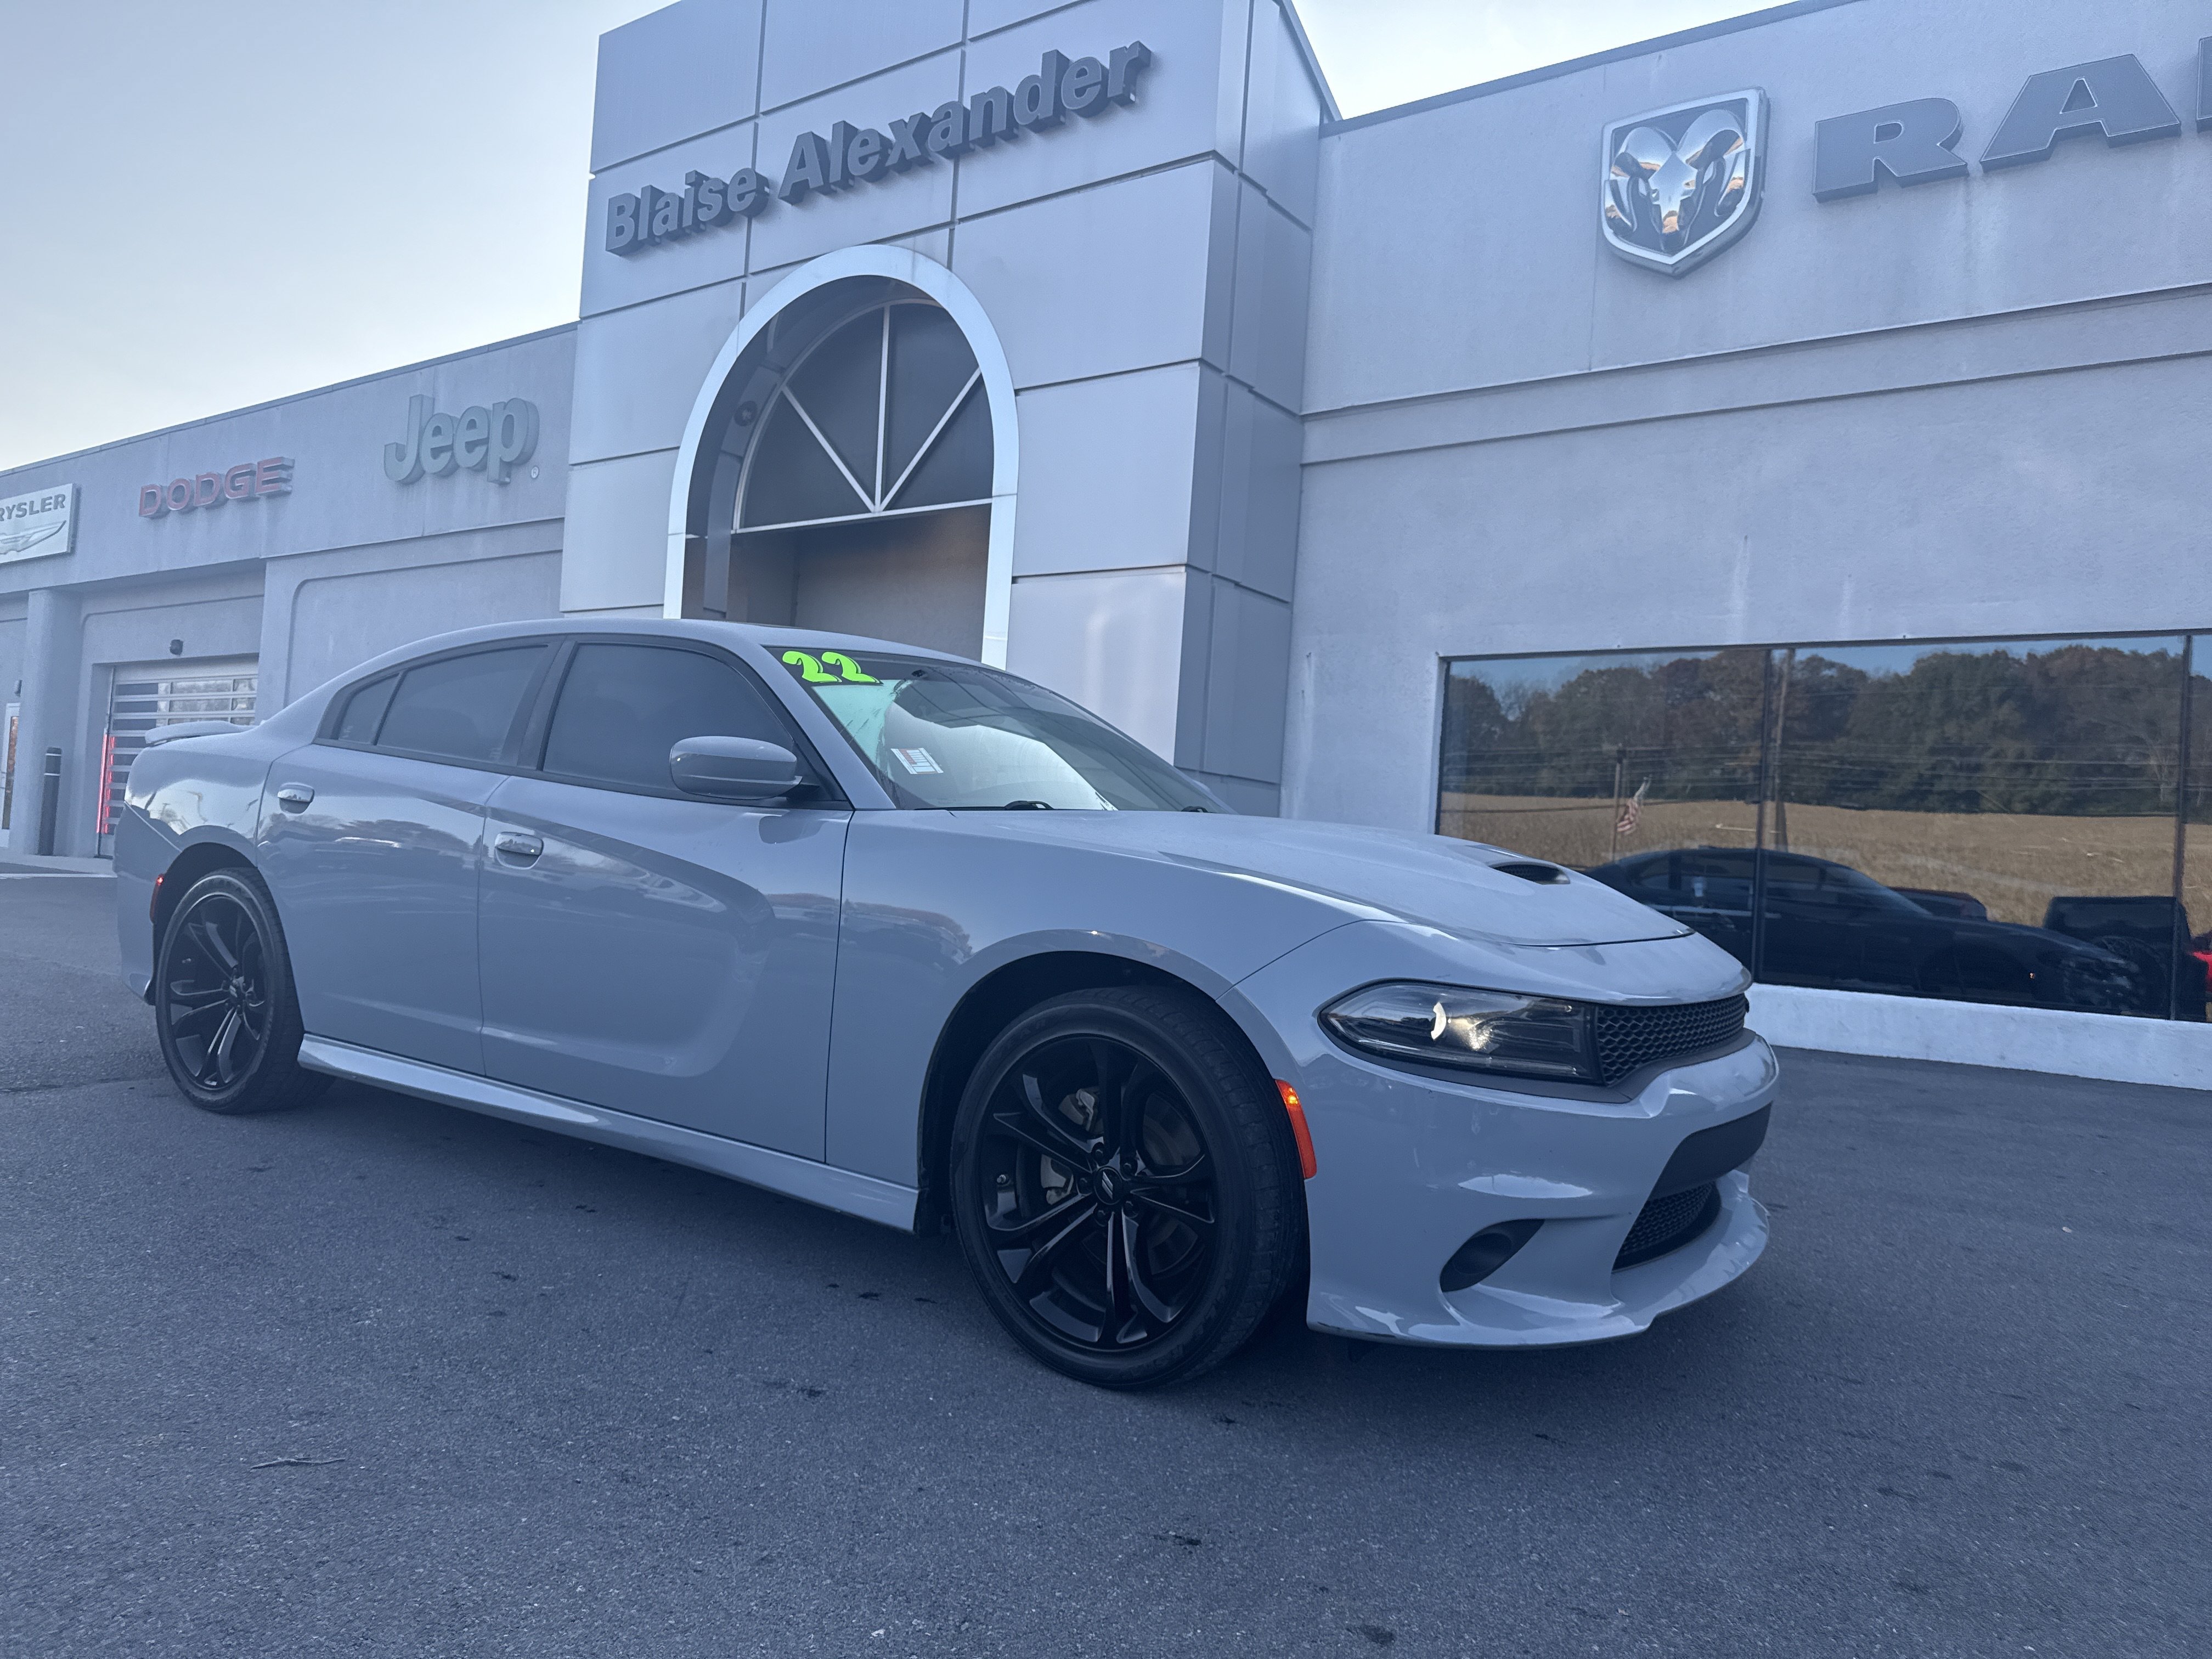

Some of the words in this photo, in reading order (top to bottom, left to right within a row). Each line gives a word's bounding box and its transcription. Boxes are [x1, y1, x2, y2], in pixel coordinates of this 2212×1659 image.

[606, 166, 770, 256] Blaise
[778, 41, 1152, 206] Alexander
[1812, 36, 2212, 203] RA
[384, 394, 539, 484] Jeep
[138, 456, 295, 517] DODGE
[782, 651, 884, 684] 22
